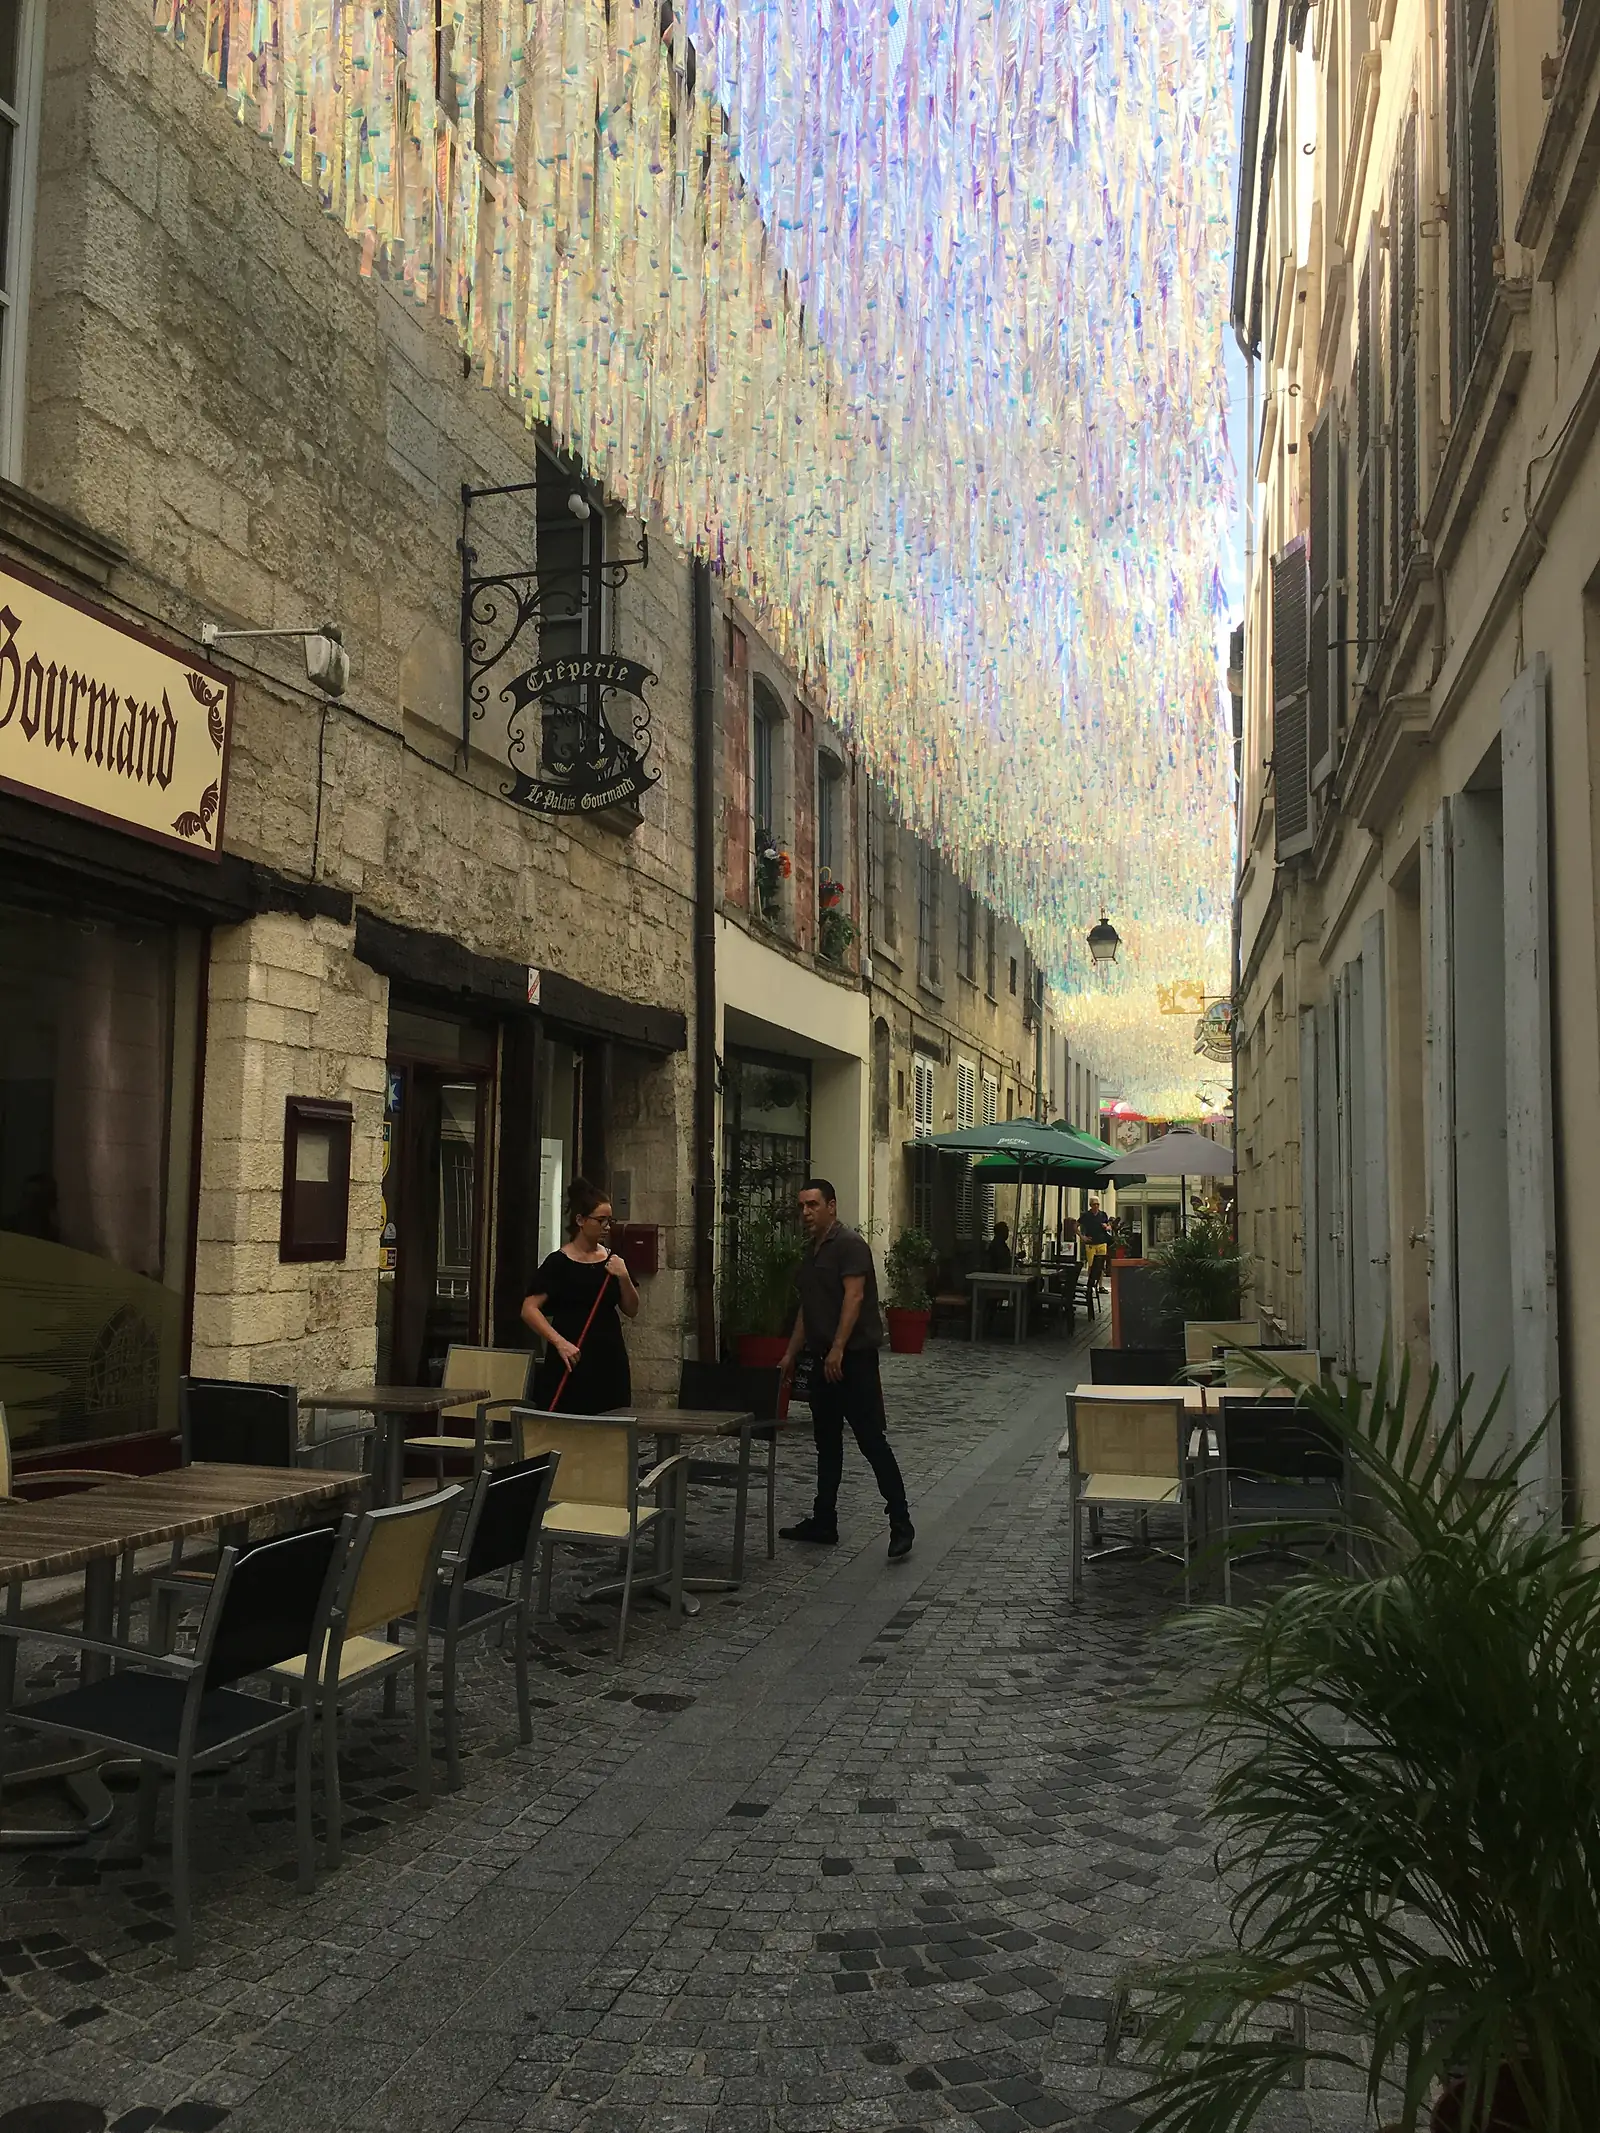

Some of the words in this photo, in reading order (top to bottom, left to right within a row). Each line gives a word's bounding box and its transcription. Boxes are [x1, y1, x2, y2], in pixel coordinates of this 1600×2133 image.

[526, 660, 629, 692] Crêperie
[524, 784, 539, 804] Le
[542, 789, 576, 811] Palais
[581, 777, 636, 810] Gourmand
